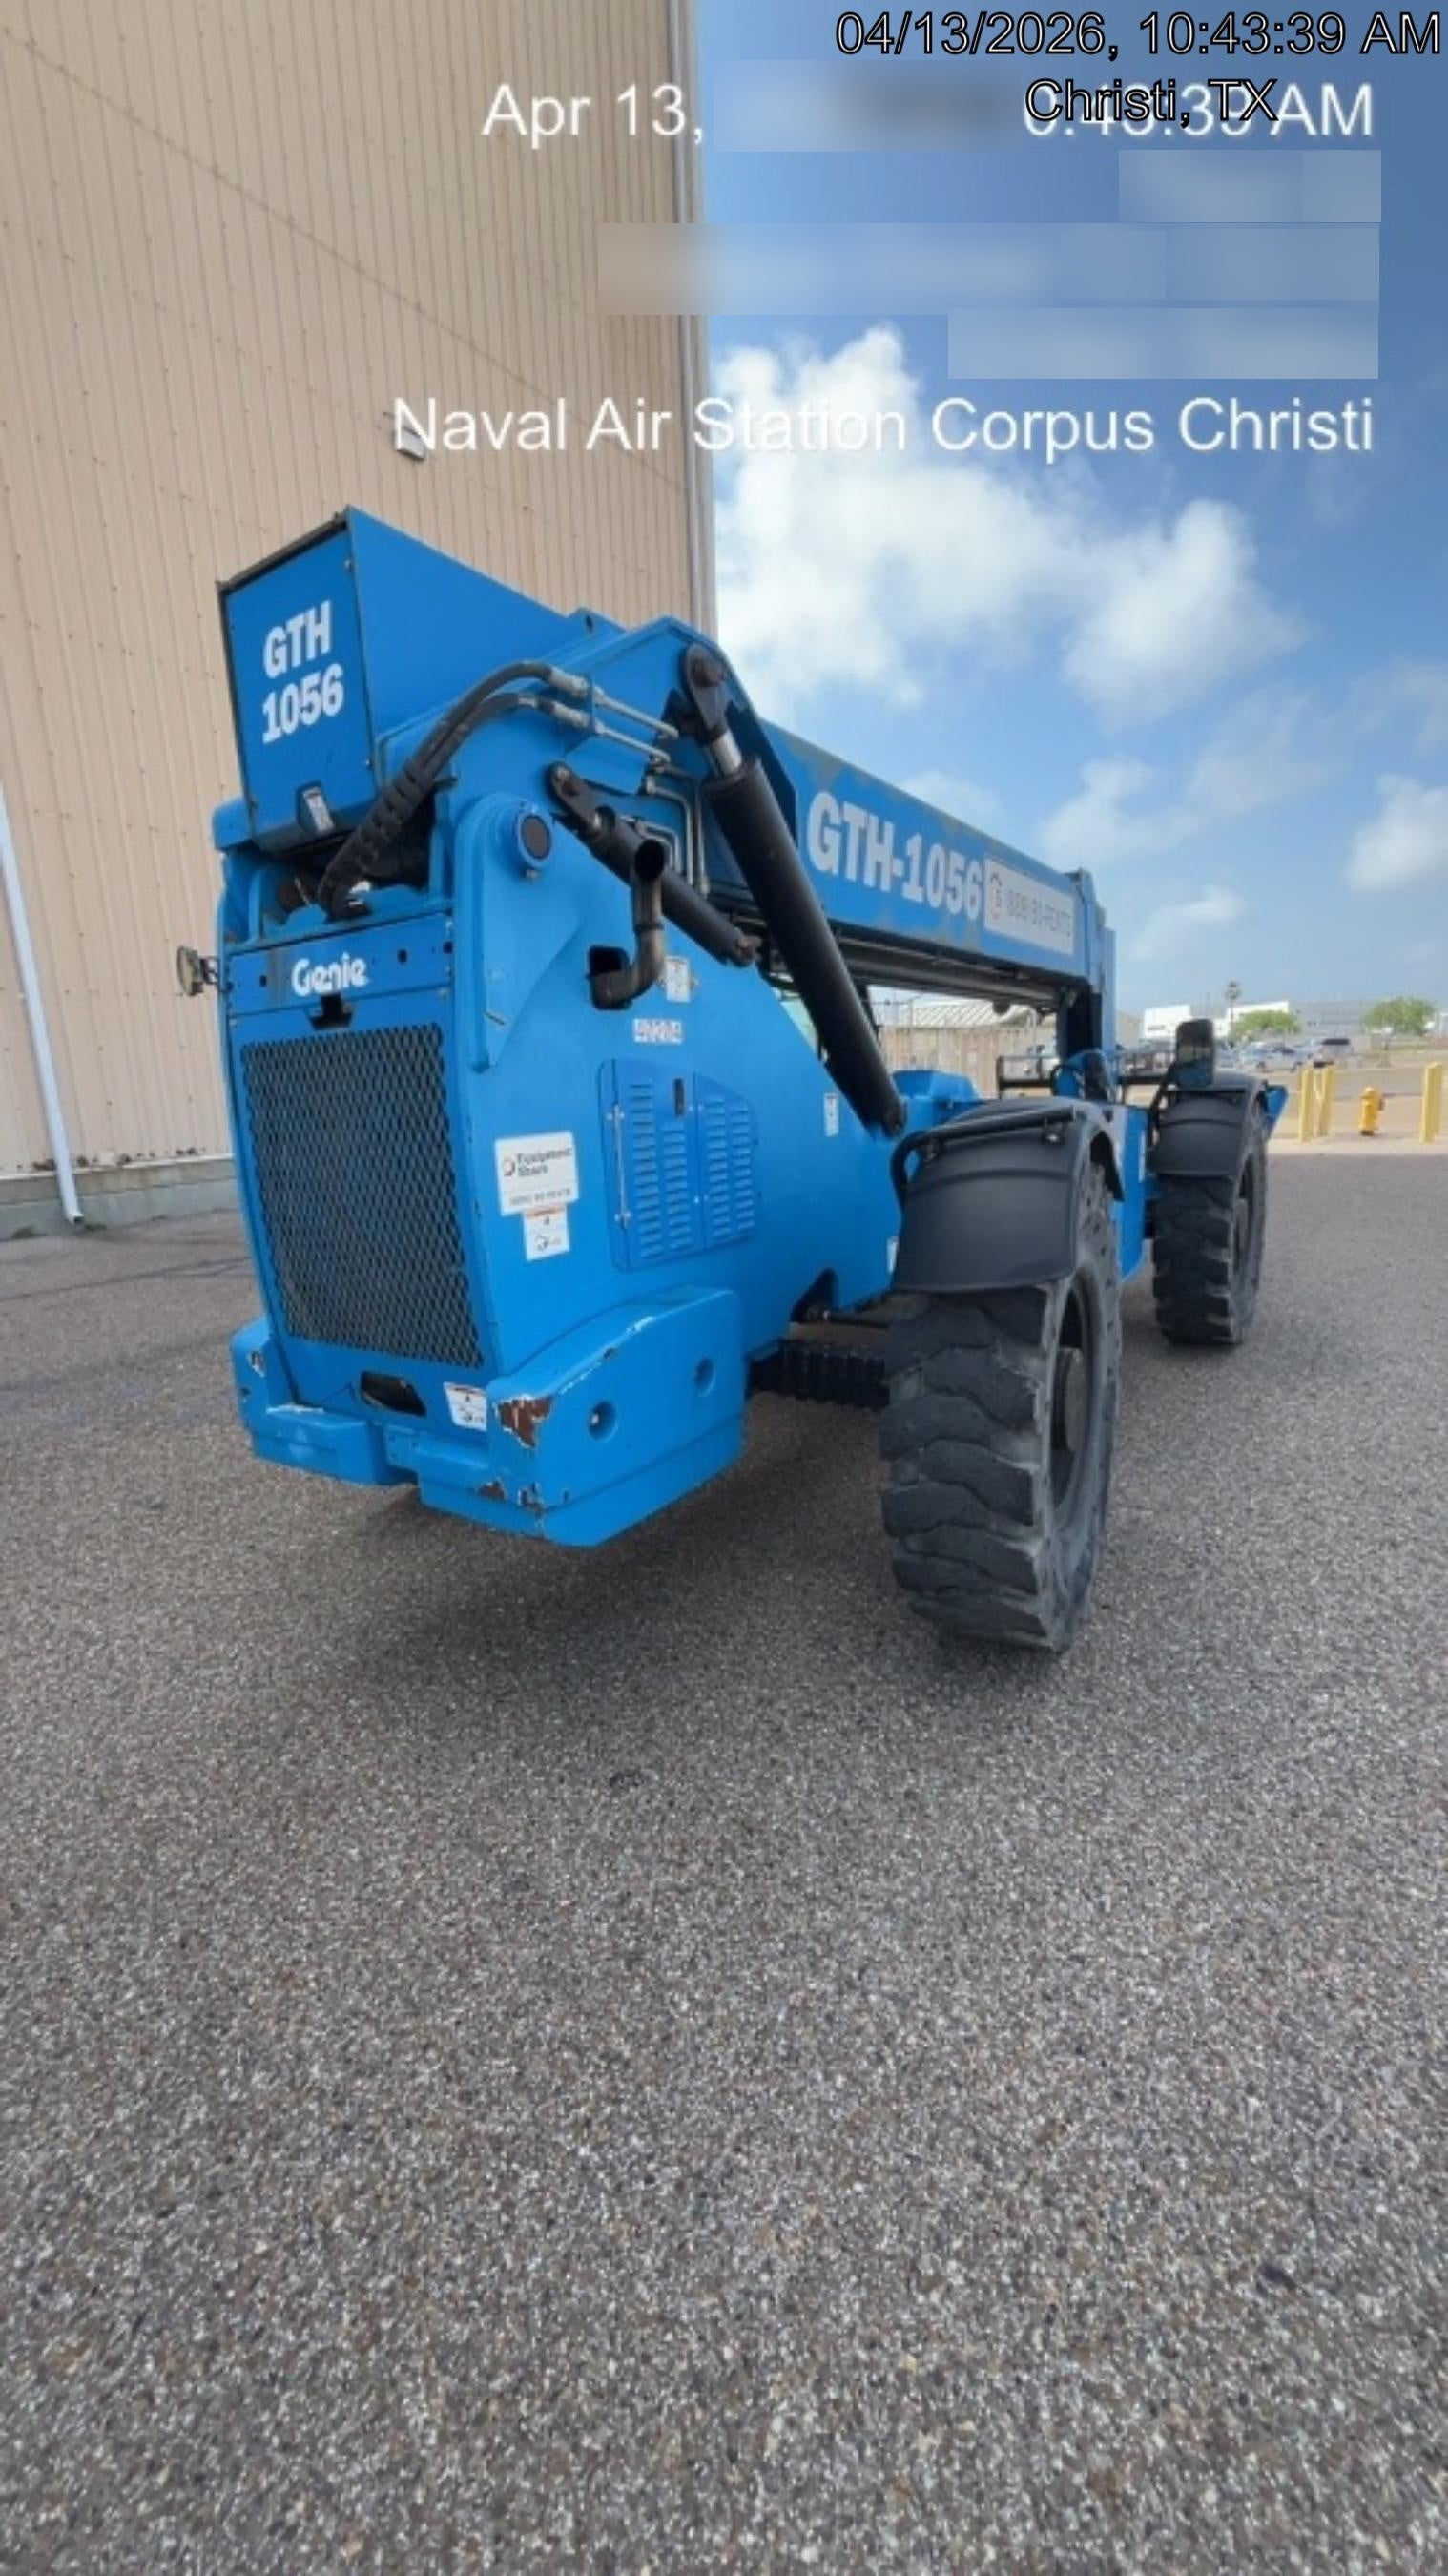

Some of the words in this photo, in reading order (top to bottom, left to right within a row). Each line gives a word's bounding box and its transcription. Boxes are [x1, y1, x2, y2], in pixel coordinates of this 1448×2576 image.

[263, 600, 332, 679] GTH
[262, 663, 345, 744] 1056
[806, 791, 983, 922] GTH-1056
[291, 950, 370, 998] Genie
